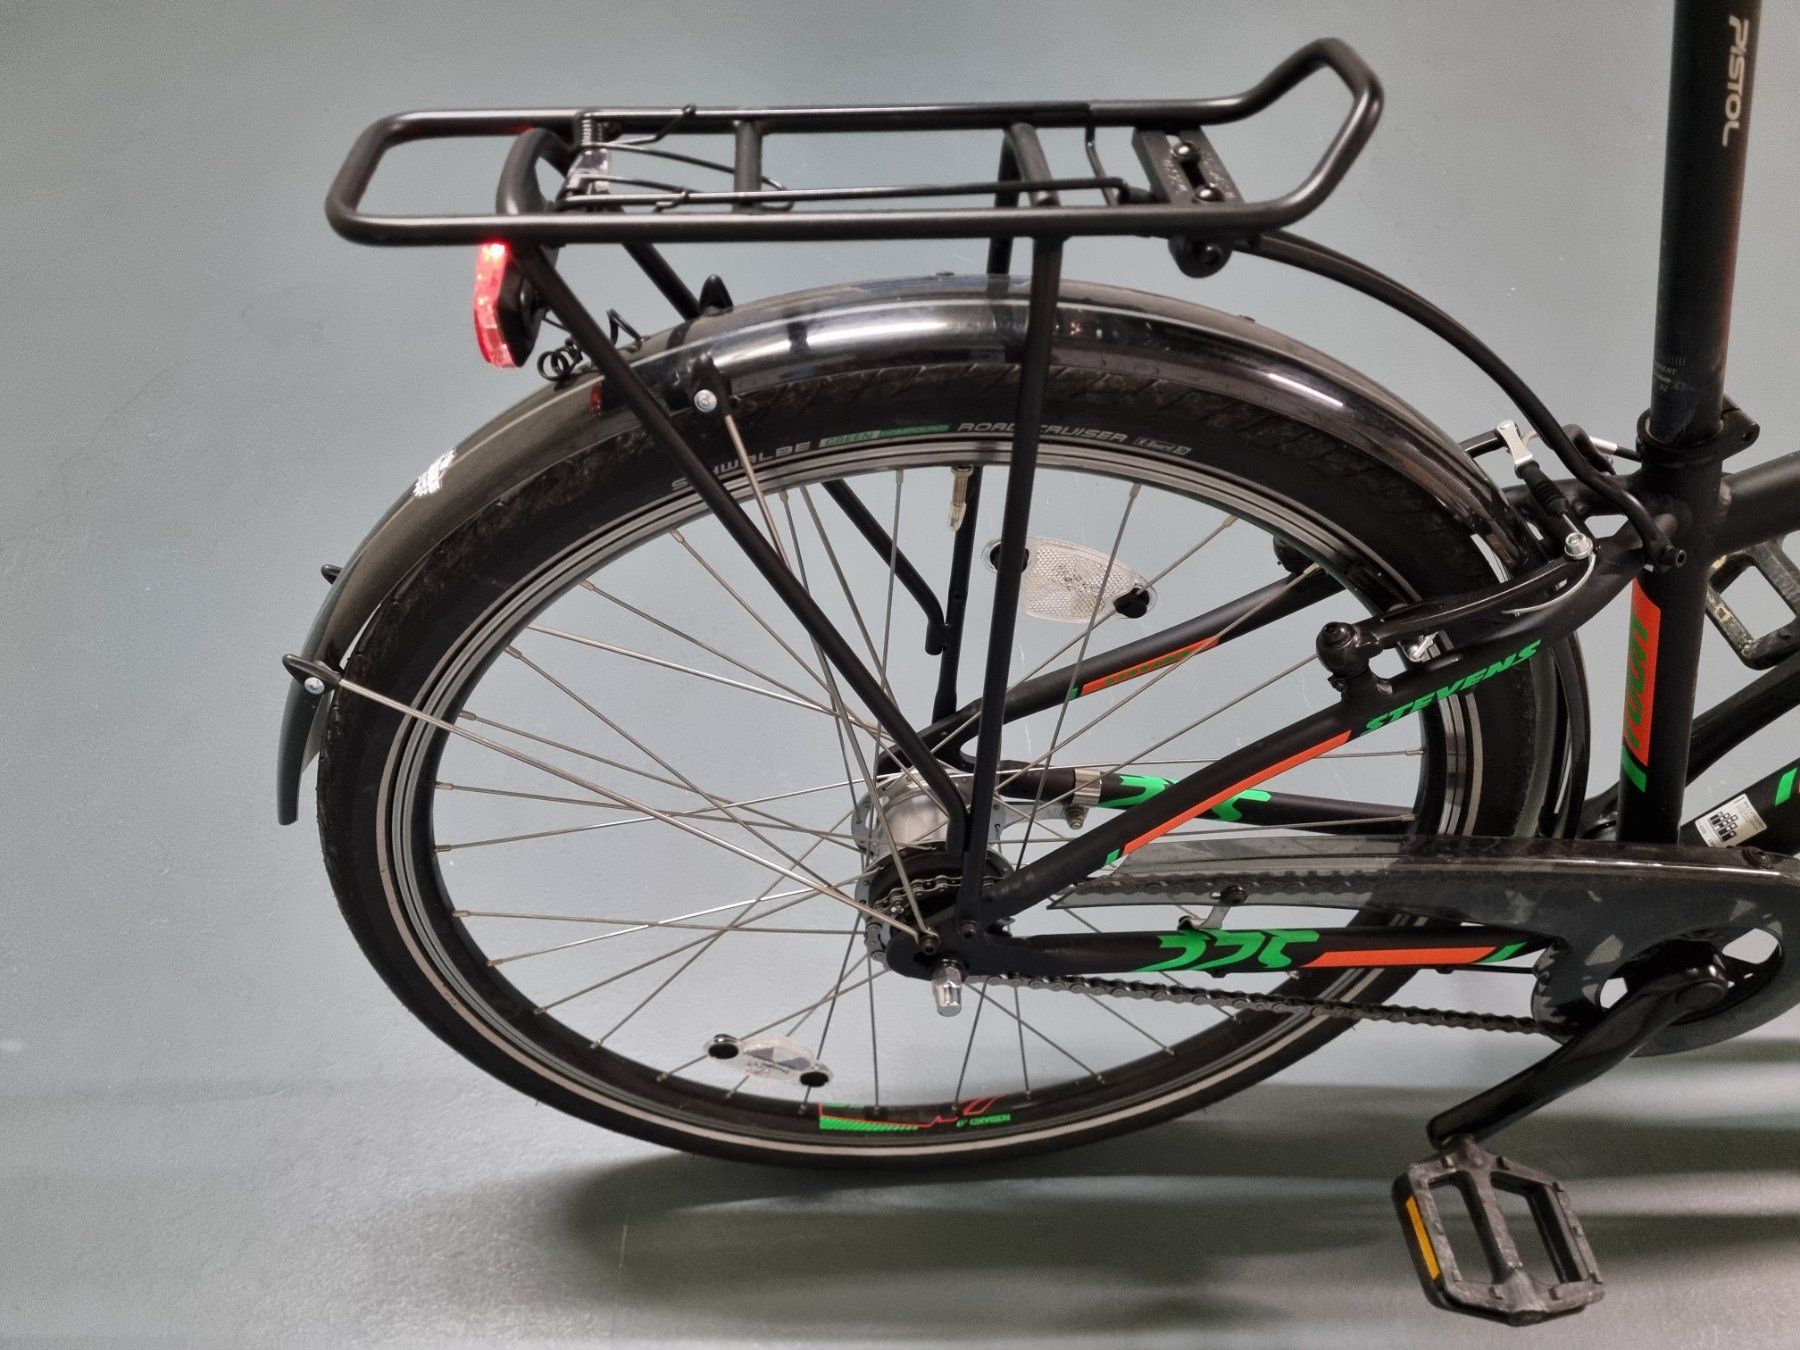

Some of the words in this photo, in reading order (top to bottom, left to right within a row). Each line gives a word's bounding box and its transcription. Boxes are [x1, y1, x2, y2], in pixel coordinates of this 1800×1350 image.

[1721, 15, 1749, 147] PISTOL
[671, 441, 811, 492] SWALBE
[1361, 638, 1542, 737] STEVENS
